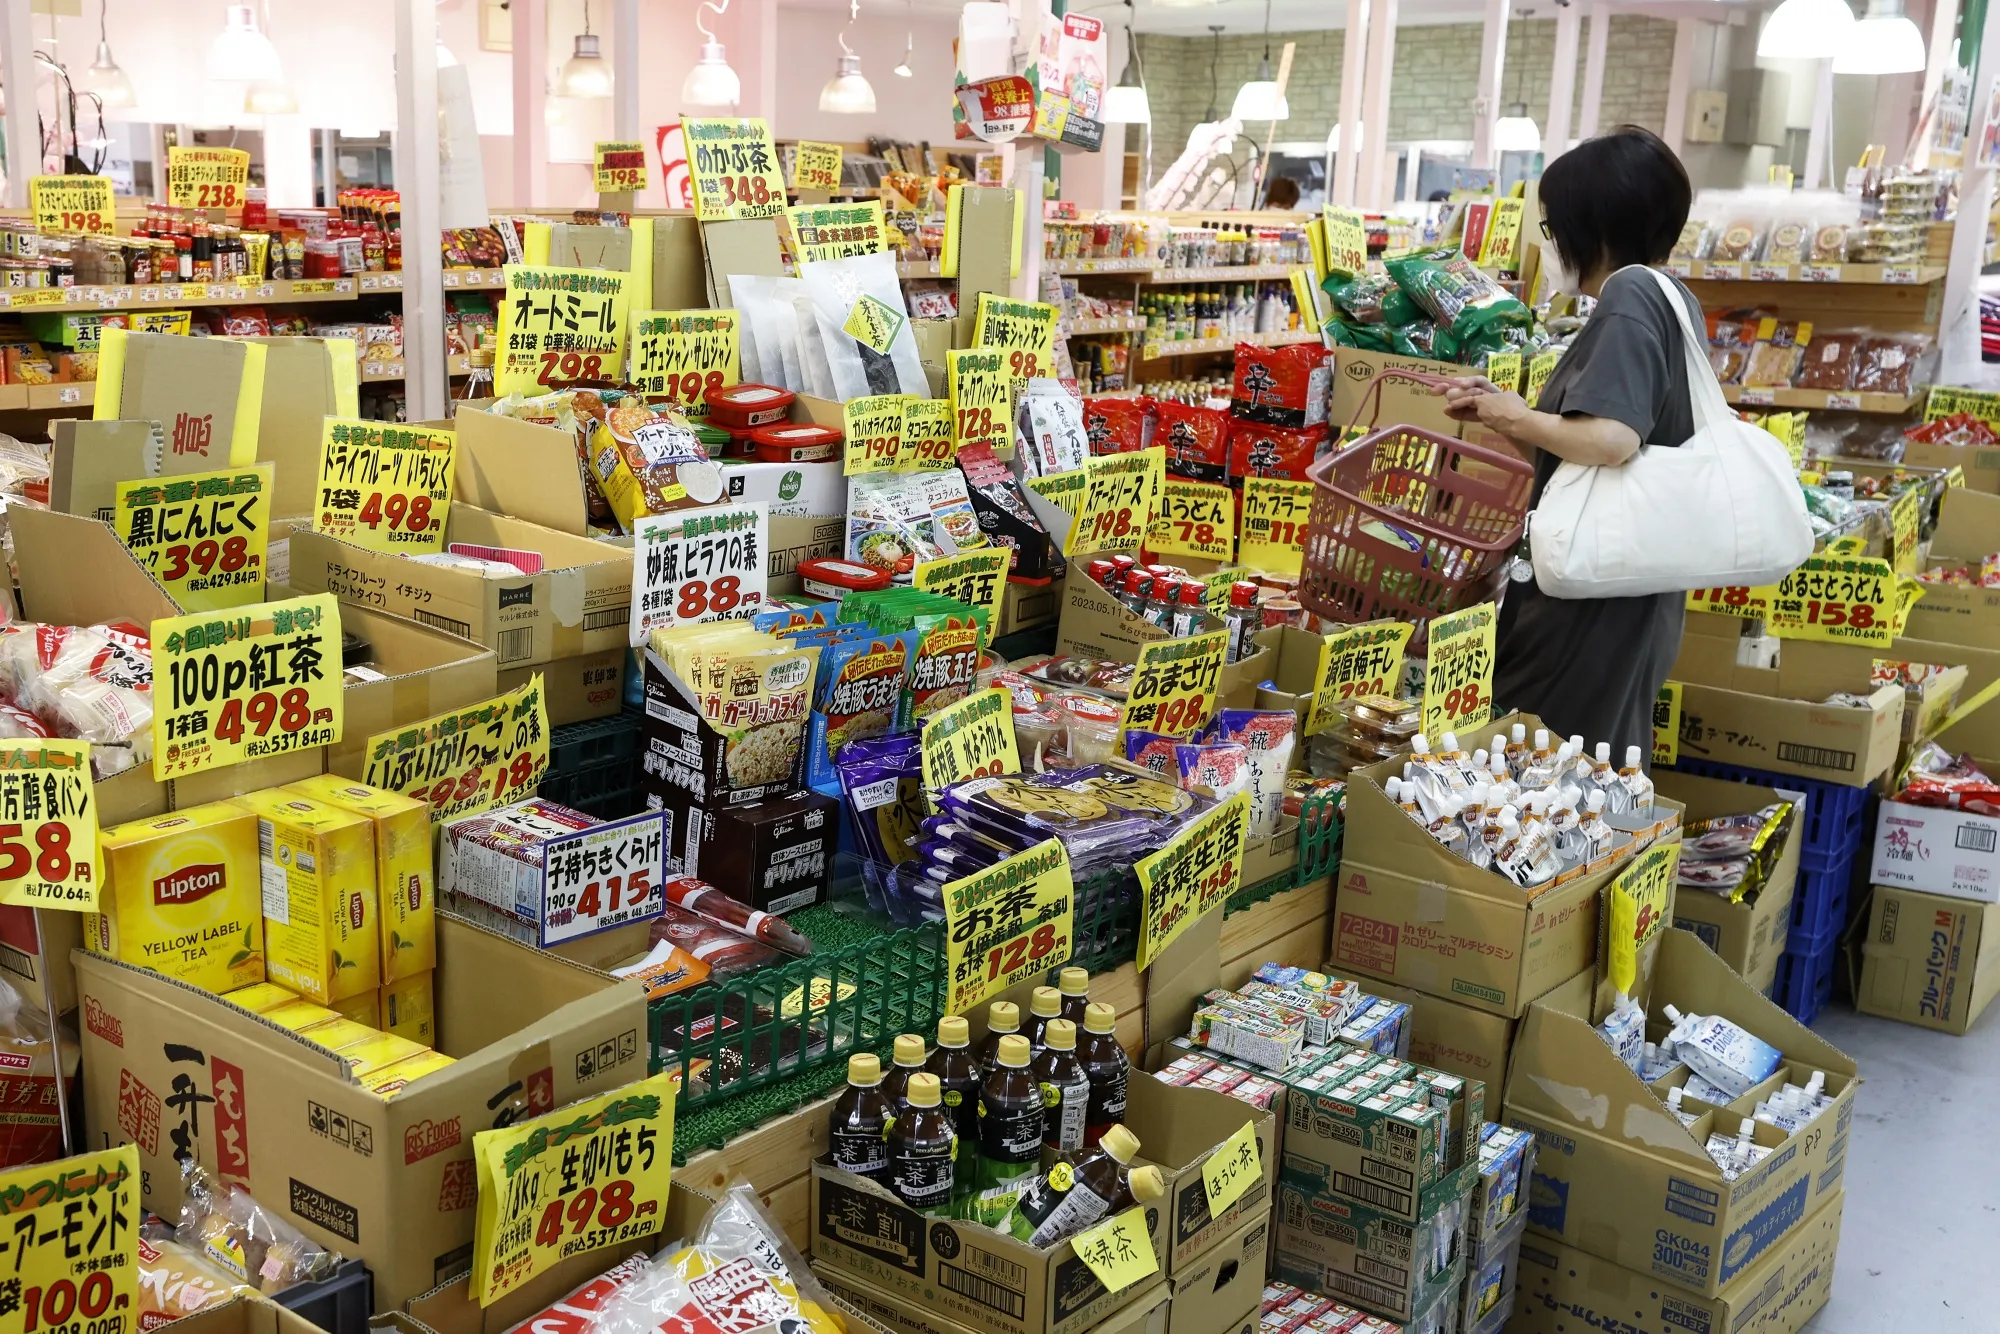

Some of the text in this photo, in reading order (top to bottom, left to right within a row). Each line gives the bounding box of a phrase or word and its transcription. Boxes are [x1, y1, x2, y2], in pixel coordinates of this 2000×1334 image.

[696, 142, 771, 174] めかぶ茶
[699, 176, 782, 206] 1袋 348円
[61, 213, 112, 231] 198円
[794, 208, 874, 226] 京都府産
[513, 272, 622, 295] お湯を入れて混ぜるだけ!
[515, 292, 616, 333] オートミール
[509, 334, 537, 350] 各1袋
[983, 317, 1046, 350] 創味シャンタン
[636, 376, 663, 392] 各1個
[1383, 361, 1458, 375] ドリップコーヒー
[1243, 362, 1277, 409] 辛
[1168, 420, 1198, 466] 辛
[324, 445, 452, 491] ドライフルーツ いちじく
[126, 475, 261, 509] 定番商品
[1085, 475, 1143, 513] ステーキソース
[128, 496, 258, 549] 黒にんにく
[322, 488, 440, 532] 1袋 498円
[1091, 508, 1141, 541] 198円
[1245, 517, 1269, 530] 1個
[319, 526, 356, 536] アキダイ
[387, 532, 436, 543] (税込537.84円)
[644, 510, 758, 545] チョー簡単味付け
[1173, 521, 1227, 546] 78円
[163, 536, 259, 581] 398円
[646, 532, 757, 588] 炒飯、ピラフの素
[1188, 544, 1227, 555] (税込84.24円)
[186, 571, 261, 591] (税込429.84円)
[326, 561, 432, 603] ドライフルーツ イチジク
[585, 588, 614, 596] ドライフルーツ
[642, 575, 760, 618] 各種1袋 88円
[1779, 573, 1884, 604] ふるさとうどん
[498, 609, 539, 622] マルレ株式会社
[1071, 595, 1122, 618] 2023.05.11
[1707, 604, 1766, 618] (税込127.44円)
[1807, 601, 1887, 628] 158円
[160, 605, 322, 656] 今回限り! 激安!
[1826, 628, 1888, 640] (税込170.64円)
[170, 635, 324, 710] 100p紅茶
[734, 666, 753, 674] Glico
[768, 674, 803, 687] ソース仕上げ
[912, 649, 977, 690] 焼豚五目
[1133, 654, 1221, 700] あまざけ
[1324, 647, 1394, 688] 減塩梅干し
[1431, 648, 1490, 696] マルチビタミン
[647, 685, 666, 698] Glico
[830, 671, 902, 715] 焼豚うま塩
[1444, 683, 1490, 721] 98円
[165, 688, 333, 745] 1箱 498円
[722, 690, 808, 727] ガーリックライス
[1127, 694, 1207, 732] 1袋 198円
[181, 737, 207, 751] 生鮮市場
[243, 728, 335, 758] (税込537.84円)
[374, 704, 509, 761] お買い得です♪
[1250, 731, 1269, 751] 糀
[163, 753, 213, 775] アキダイ
[181, 745, 211, 759] FRESHLAND
[651, 738, 702, 770] 液体ソース仕上げ
[644, 751, 706, 797] ガーリックライス
[774, 826, 794, 839] Glico
[547, 831, 660, 890] 子持ちきくらげ
[771, 840, 822, 864] 液体ソース仕上げ
[1149, 817, 1242, 918] 野菜生活
[159, 868, 221, 899] Lipton
[764, 852, 825, 889] ガーリックライス
[953, 845, 1063, 913] 285円の品がなんと!
[1199, 861, 1238, 903] 158円
[23, 883, 93, 903] (税込170.64円)
[409, 877, 419, 910] Lipton
[547, 869, 662, 918] 190g 415円
[1038, 895, 1068, 922] 茶割
[352, 894, 363, 929] Lipton
[952, 882, 1038, 943] お茶
[143, 921, 242, 958] YELLOW LABEL
[340, 918, 348, 942] LABEL
[1341, 915, 1394, 944] 72841
[1403, 921, 1514, 960] in ゼリー マルチビタミン
[182, 947, 208, 963] TEA
[955, 924, 1067, 983] 各1本 128円
[1401, 936, 1456, 957] カロリーゼロ
[1006, 950, 1067, 986] (税込138.24円)
[1920, 911, 1952, 1017] ブルーパック M
[953, 988, 986, 1013] アキダイ
[1319, 1099, 1355, 1115] KAGOME
[1016, 1123, 1036, 1141] 茶
[1340, 1125, 1356, 1136] 350
[1392, 1124, 1412, 1136] 6147
[558, 1125, 657, 1197] 生切りもち
[1208, 1141, 1255, 1200] ほうじ茶
[292, 1180, 355, 1222] シングルパック
[906, 1187, 930, 1195] CRAFT
[534, 1179, 658, 1249] 498円
[1313, 1200, 1349, 1216] KAGOME
[558, 1219, 656, 1260] (税込537.84円)
[843, 1229, 900, 1252] CRAFT BASE
[1387, 1223, 1407, 1236] 6147
[1655, 1229, 1711, 1259] GK044
[1083, 1225, 1137, 1270] 緑茶
[70, 1253, 129, 1275] (本体価格)
[489, 1265, 534, 1298] アキダイ
[23, 1271, 129, 1333] 100円
